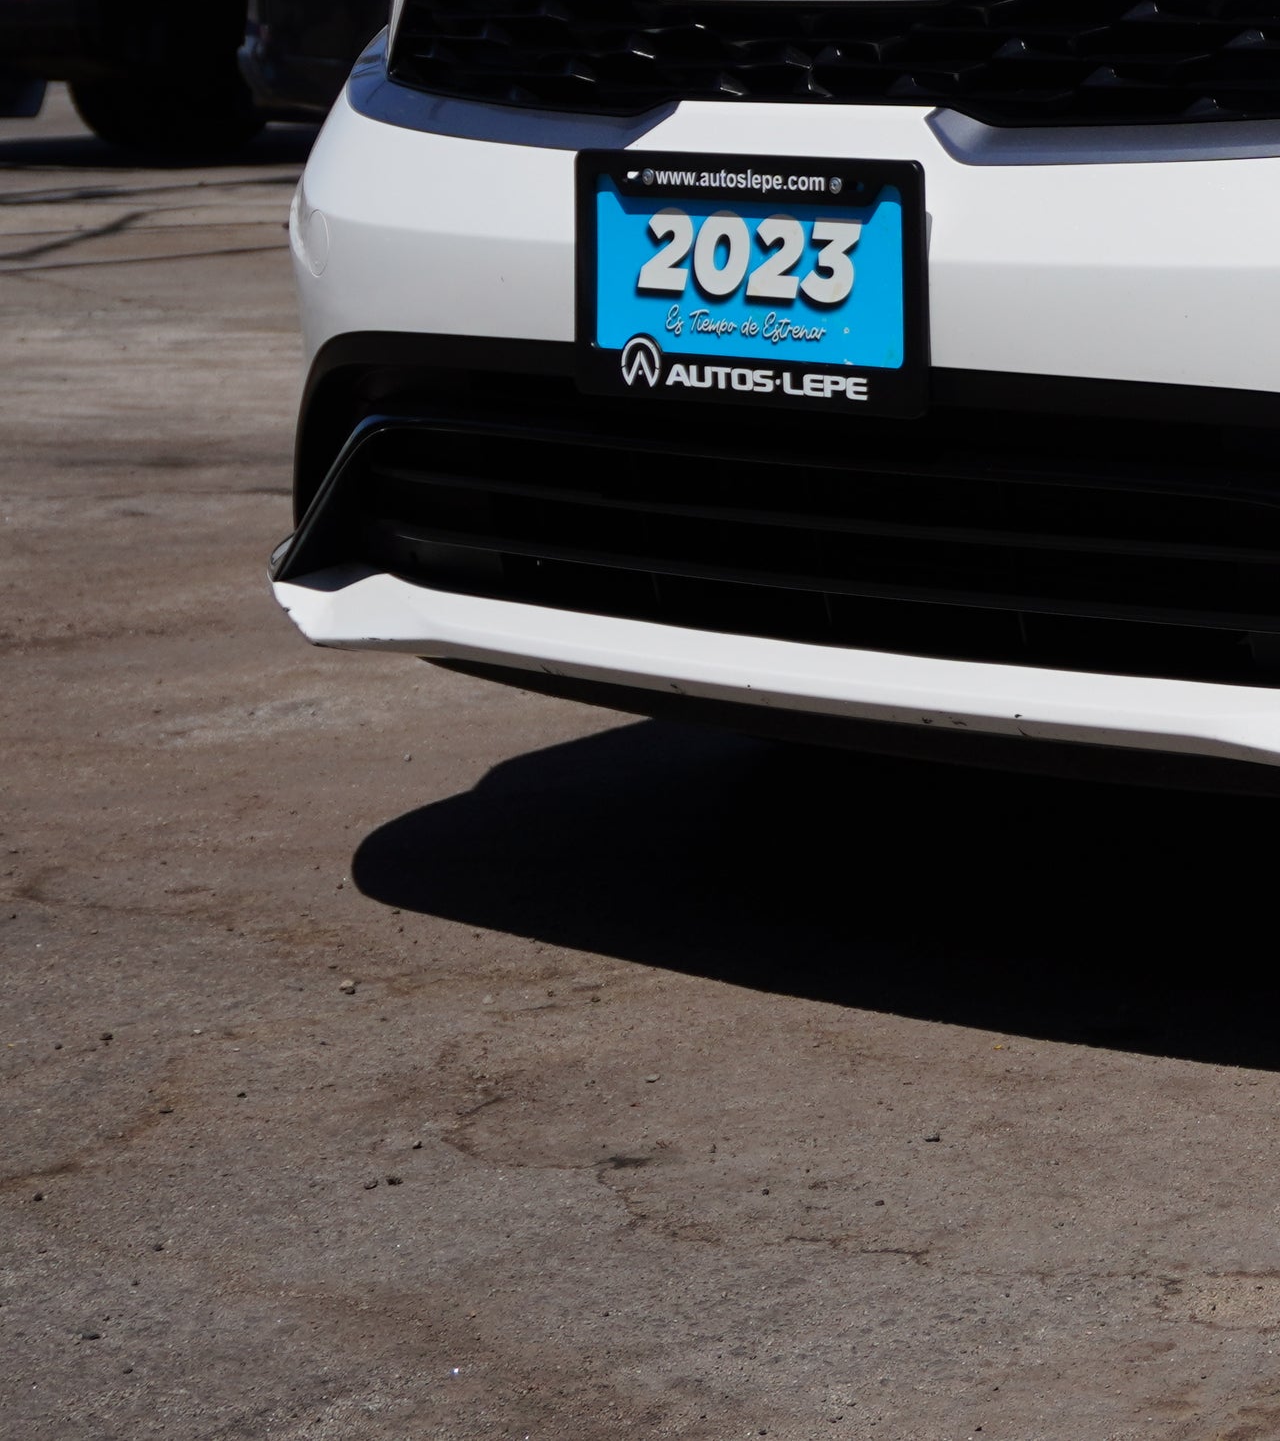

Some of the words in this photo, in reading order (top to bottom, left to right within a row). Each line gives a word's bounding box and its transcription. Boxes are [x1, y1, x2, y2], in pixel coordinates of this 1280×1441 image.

[655, 169, 825, 193] www.autoslepe.com
[638, 208, 862, 304] 2023
[665, 304, 684, 335] Es
[689, 309, 737, 337] Tiempo
[740, 315, 760, 336] de
[762, 311, 827, 343] Estrenar
